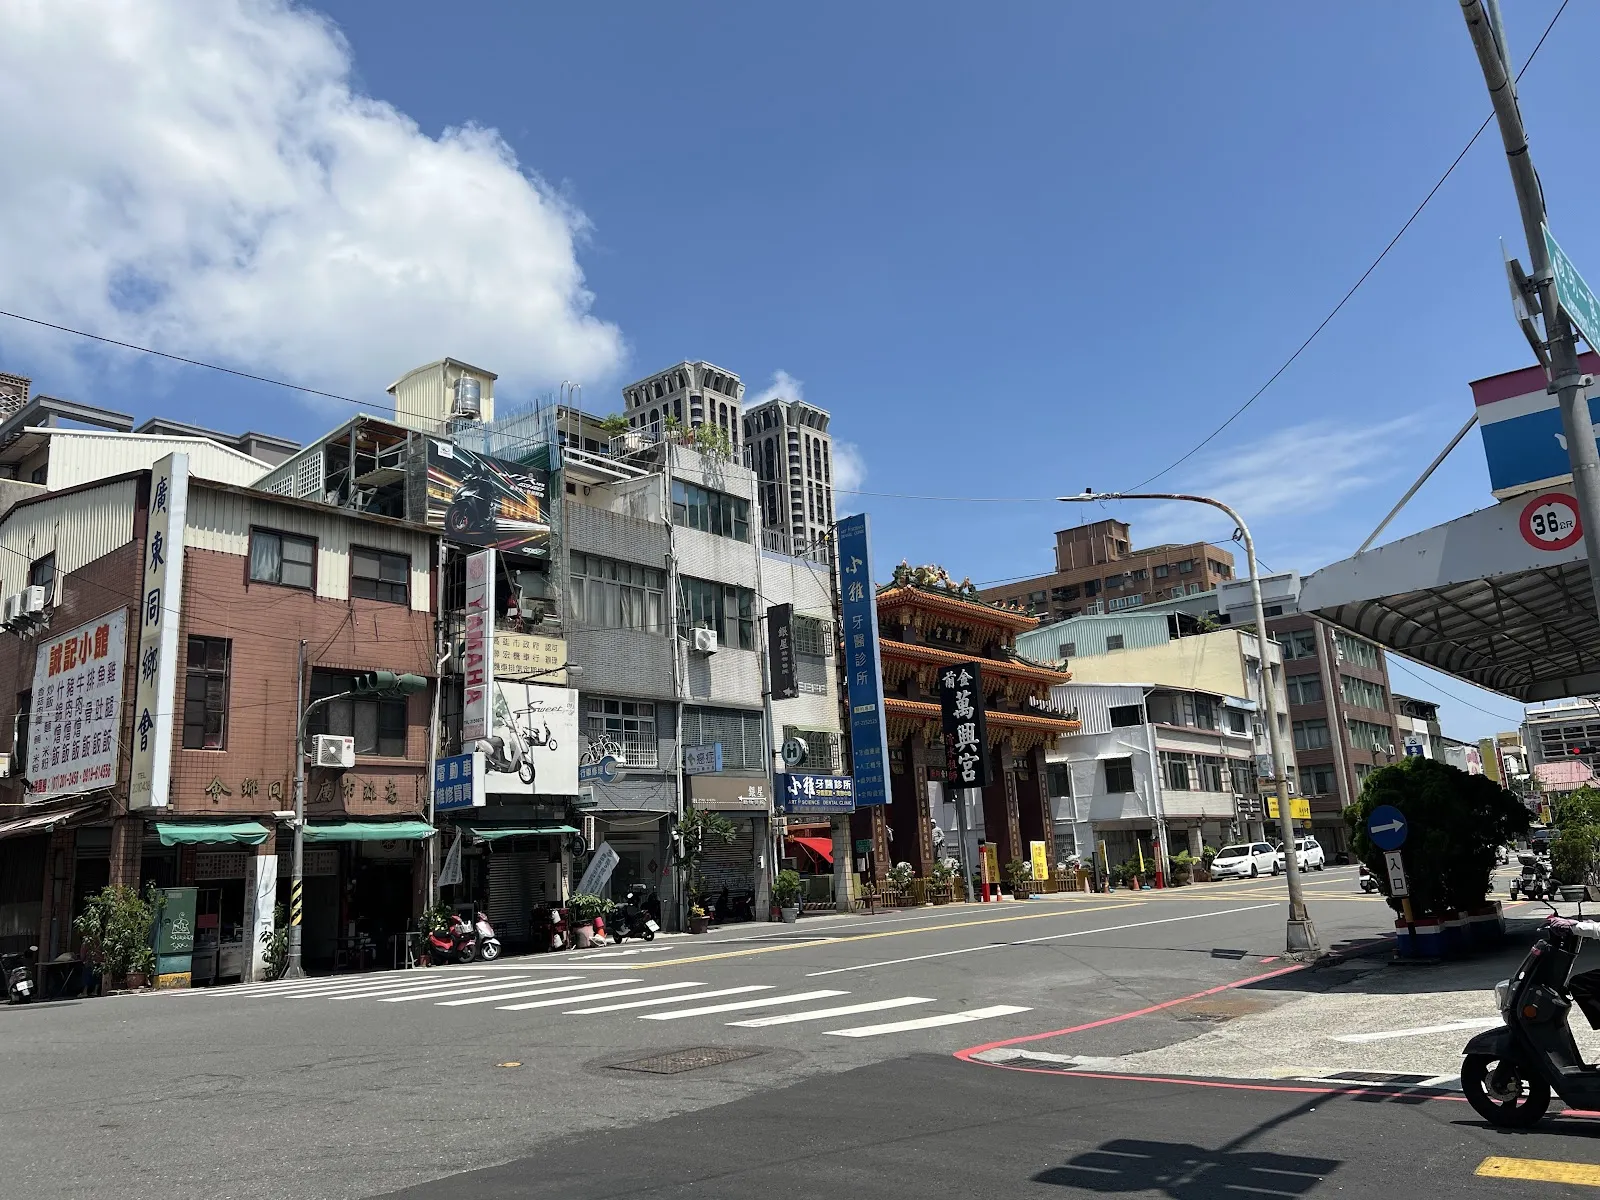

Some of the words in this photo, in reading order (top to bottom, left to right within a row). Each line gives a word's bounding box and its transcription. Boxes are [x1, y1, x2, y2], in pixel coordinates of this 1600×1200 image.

[845, 556, 864, 602] 小雅
[137, 477, 167, 754] 廣東同鄉會
[48, 624, 111, 678] 誠記小館
[467, 594, 484, 704] YAMAHA
[852, 614, 868, 686] 牙醫診所
[512, 700, 564, 716] Sweet
[953, 689, 980, 783] 萬興宮
[436, 762, 471, 783] 電動車
[436, 784, 471, 807] 維修買賣
[788, 776, 815, 801] 小雅
[815, 778, 852, 791] 牙醫診所
[1390, 857, 1404, 890] 入口
